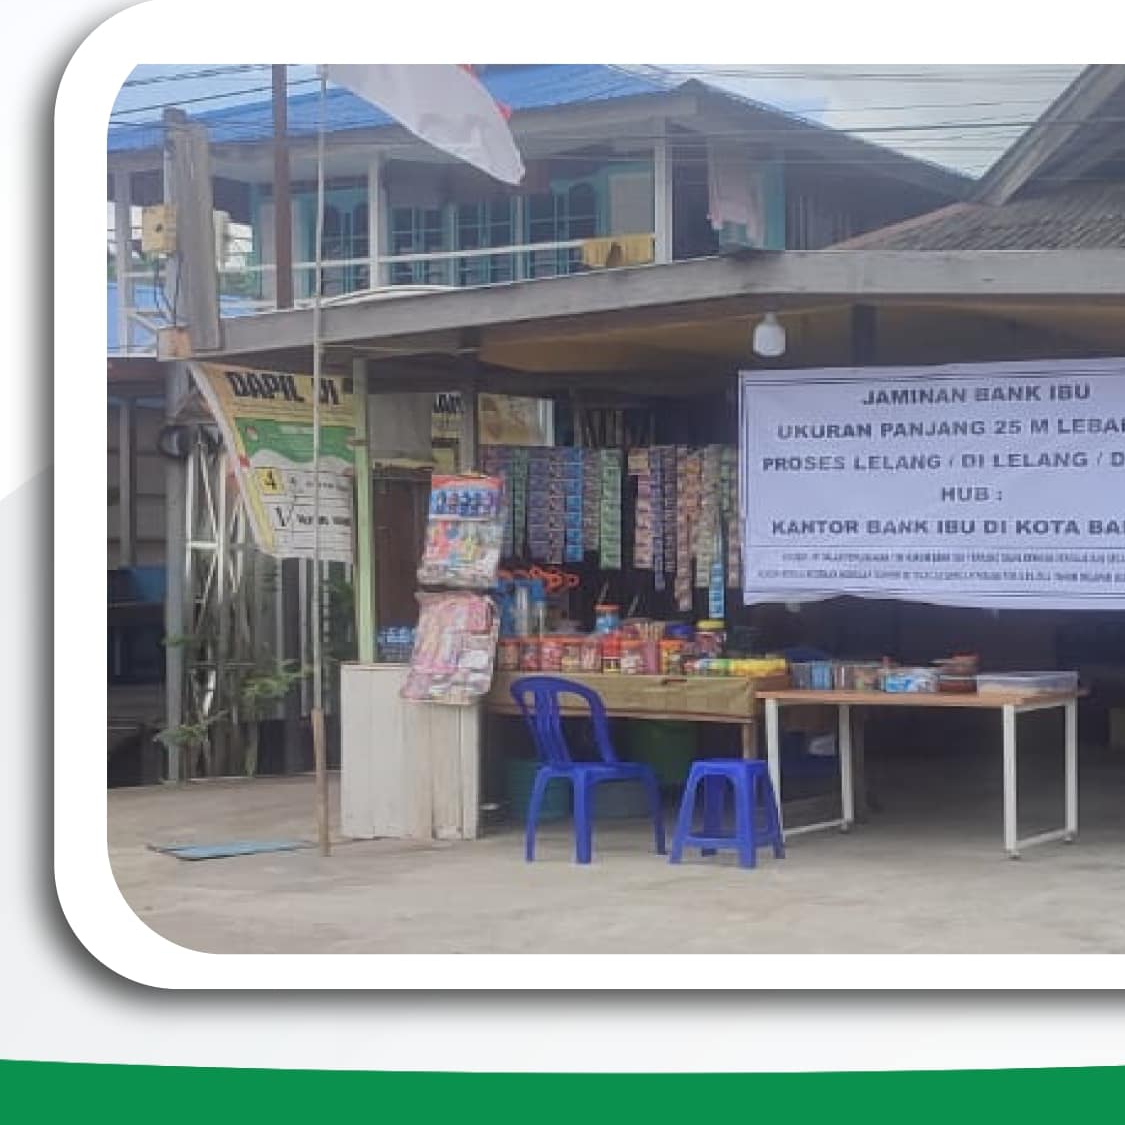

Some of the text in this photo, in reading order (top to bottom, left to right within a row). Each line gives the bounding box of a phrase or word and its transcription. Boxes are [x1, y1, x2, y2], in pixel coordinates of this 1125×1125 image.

[225, 372, 304, 402] DAPIL
[863, 384, 1090, 405] JAMINAN BANK IBU
[778, 423, 871, 439] UKURAN
[881, 421, 984, 437] PANJANG
[994, 420, 1021, 434] 25
[1031, 419, 1048, 434] M
[763, 456, 844, 471] PROSES
[854, 455, 940, 470] LELANG
[962, 454, 984, 468] DI
[994, 452, 1087, 467] LELANG
[264, 471, 276, 490] 4
[942, 487, 989, 502] HUB
[773, 520, 859, 535] KANTOR
[867, 520, 928, 534] BANK
[937, 520, 975, 534] IBU
[984, 520, 1006, 534] DI
[1016, 520, 1080, 535] KOTA
